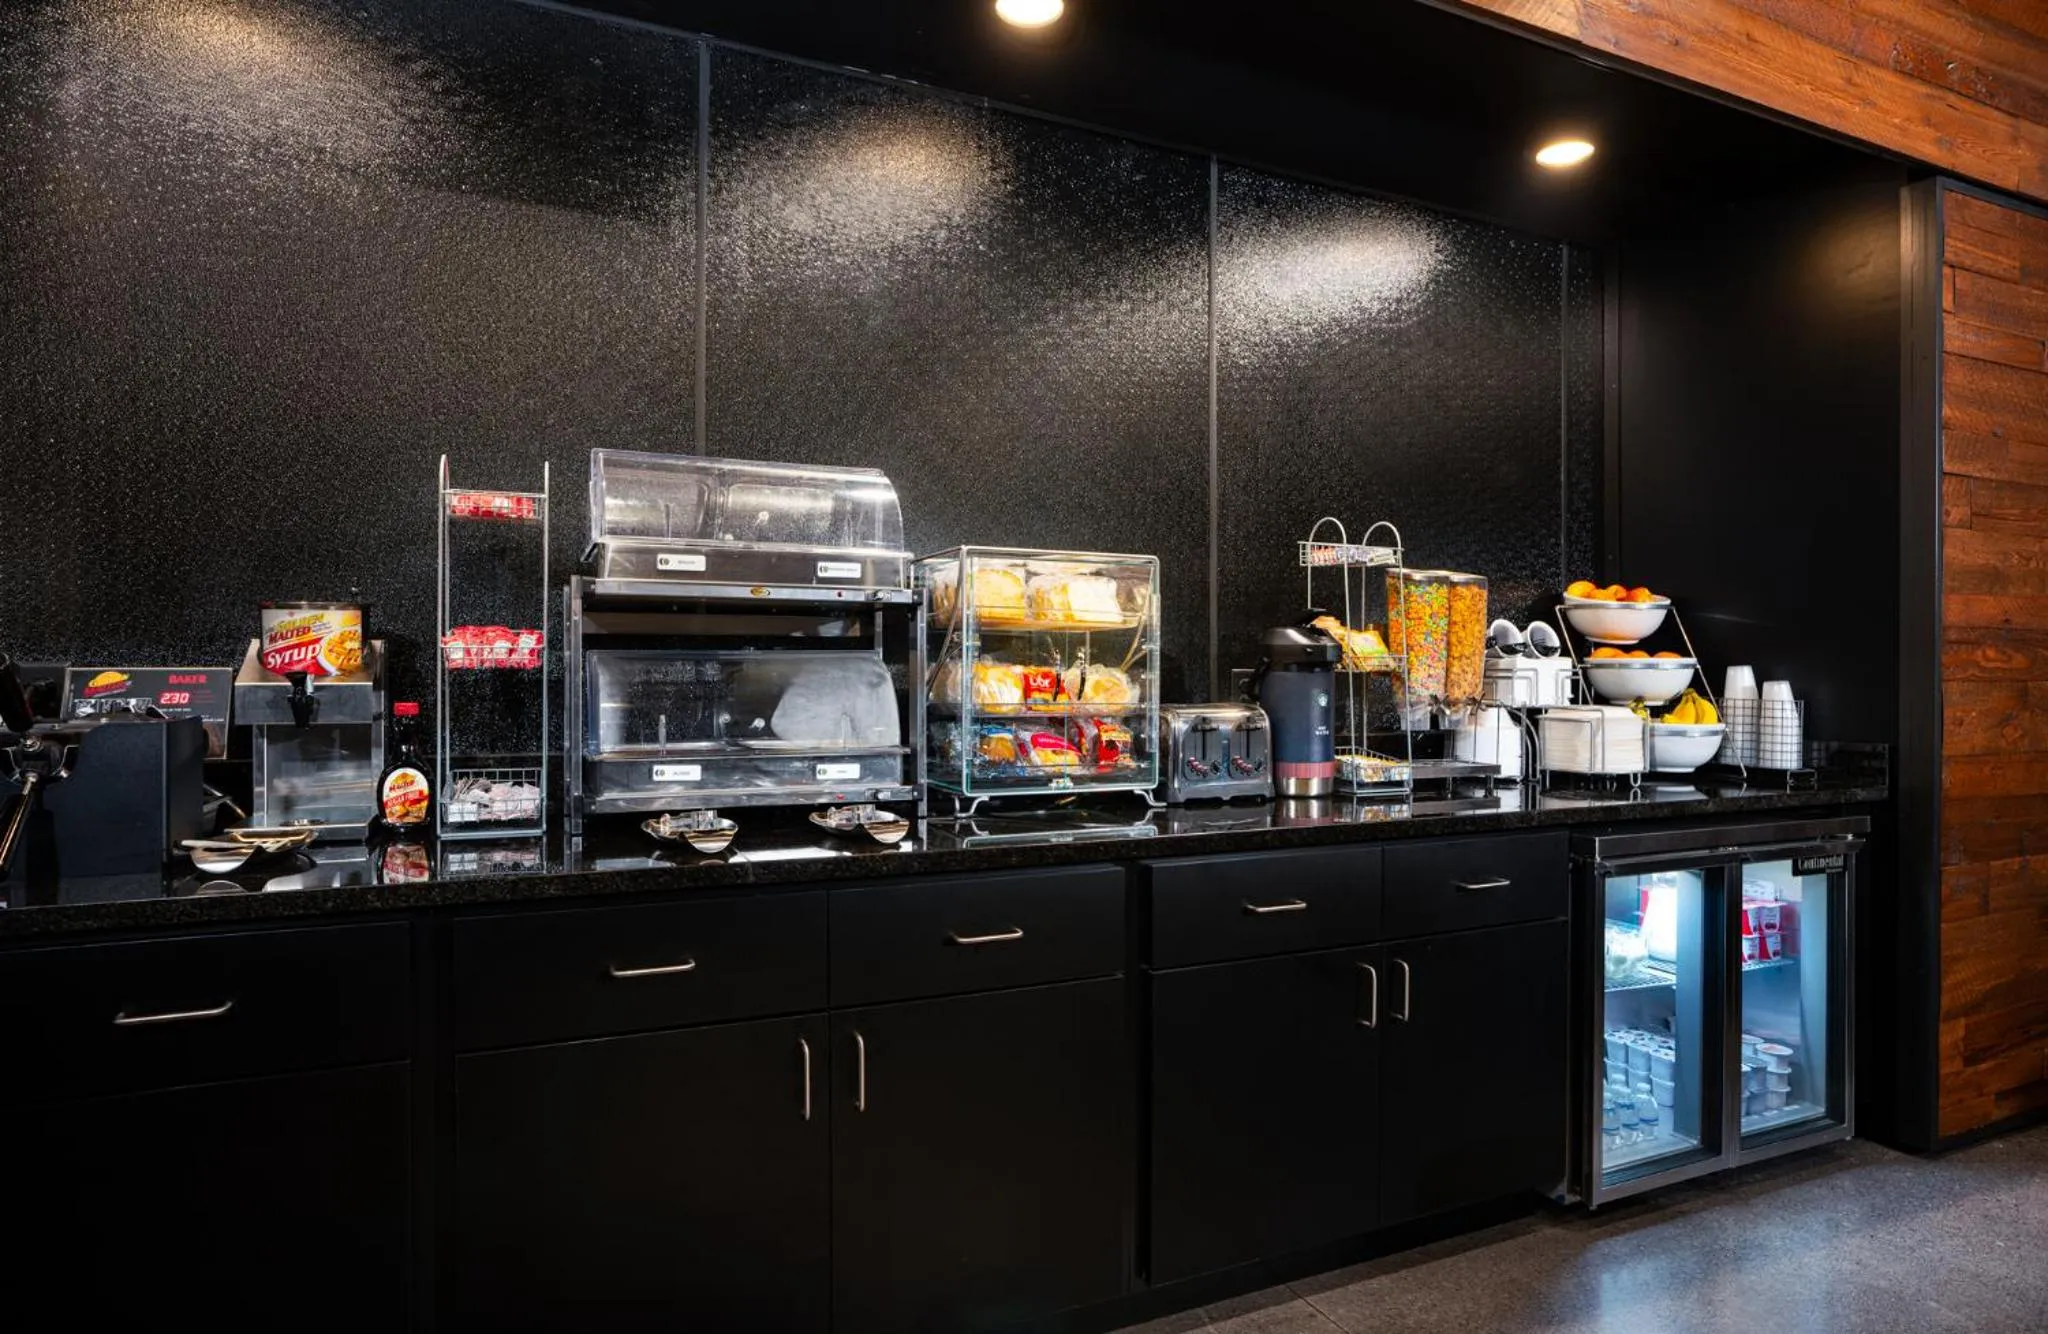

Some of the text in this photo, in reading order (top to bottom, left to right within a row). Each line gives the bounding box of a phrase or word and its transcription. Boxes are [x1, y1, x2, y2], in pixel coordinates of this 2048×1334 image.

[268, 626, 311, 645] MALTED
[266, 643, 320, 668] Syrup
[160, 692, 190, 704] 230
[1797, 855, 1844, 870] Continental
